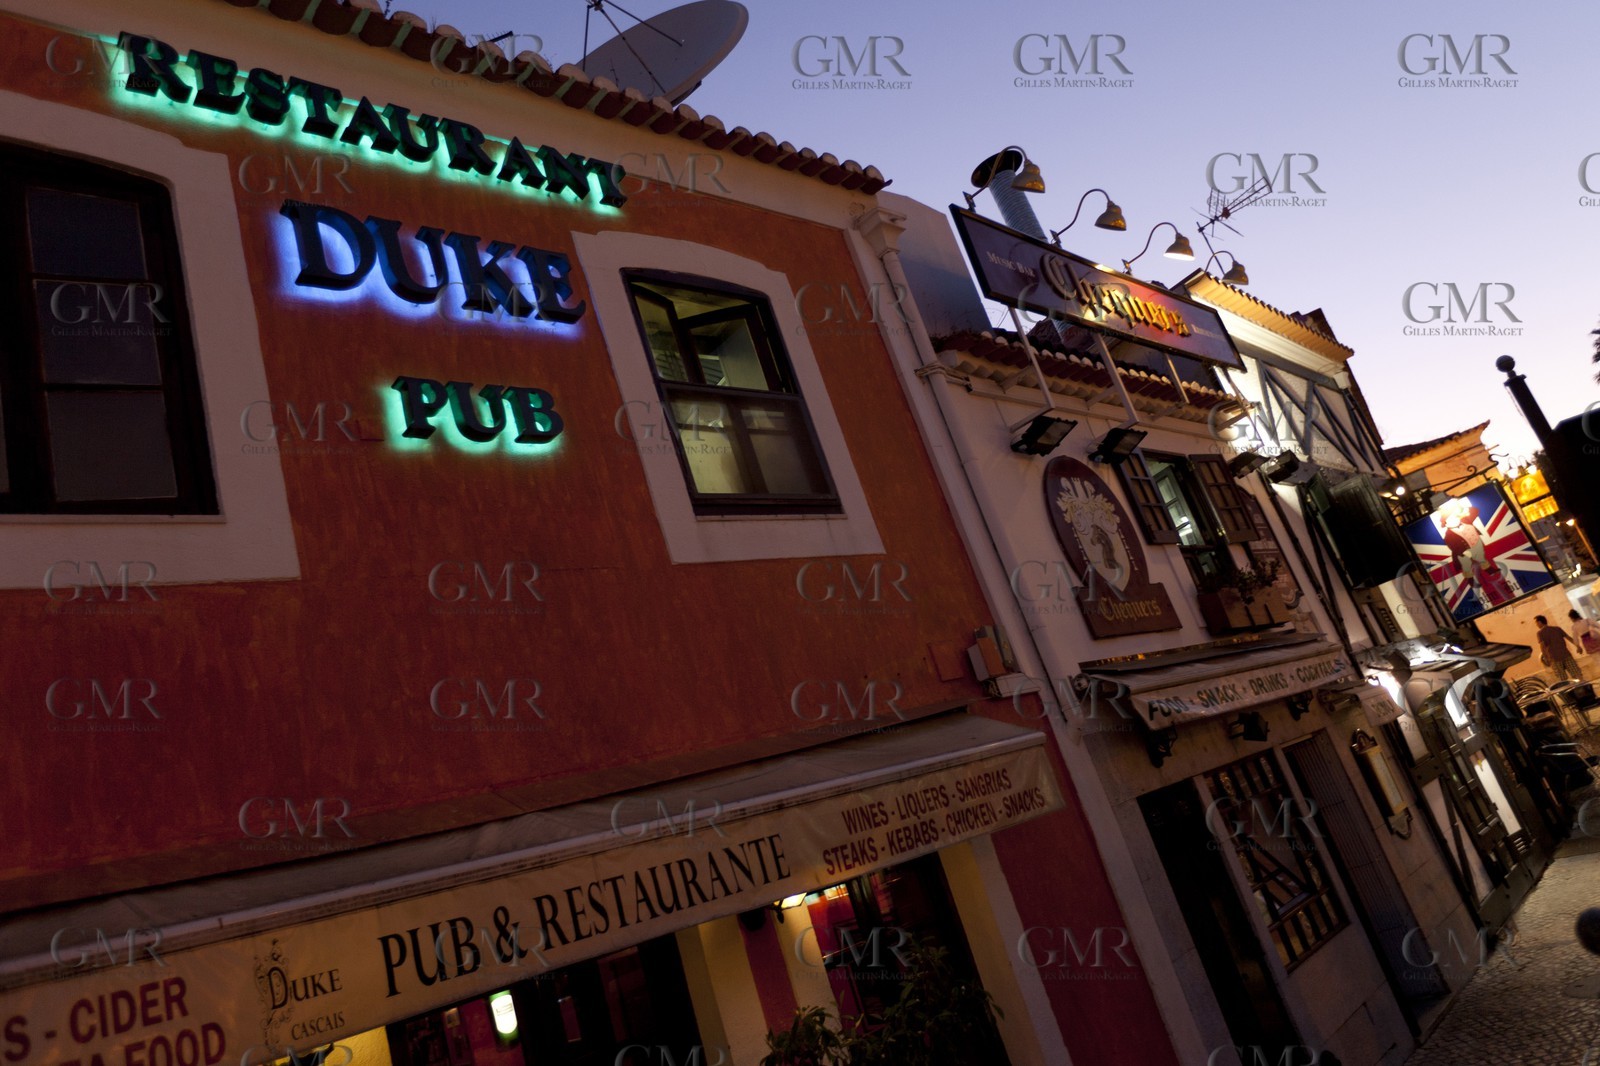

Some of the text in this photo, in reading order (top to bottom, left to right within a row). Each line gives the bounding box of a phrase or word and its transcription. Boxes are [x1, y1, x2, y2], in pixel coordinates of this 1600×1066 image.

[115, 31, 627, 210] RESTAURANT
[279, 200, 587, 324] DUKE
[391, 376, 565, 444] PUB
[1099, 595, 1163, 622] Chequers
[1147, 656, 1346, 721] FOOD SNACK DRINKS COCKTAILS
[822, 786, 1046, 876] STEAKS KEBABS CHICKEN SNACKS
[841, 768, 1012, 836] WINES LIQUERS SANGRIAS
[377, 833, 792, 998] PUB & RESTAURANTE
[69, 976, 189, 1046] CIDER
[268, 965, 344, 1011] DUKE
[290, 1011, 347, 1042] CASCAIS
